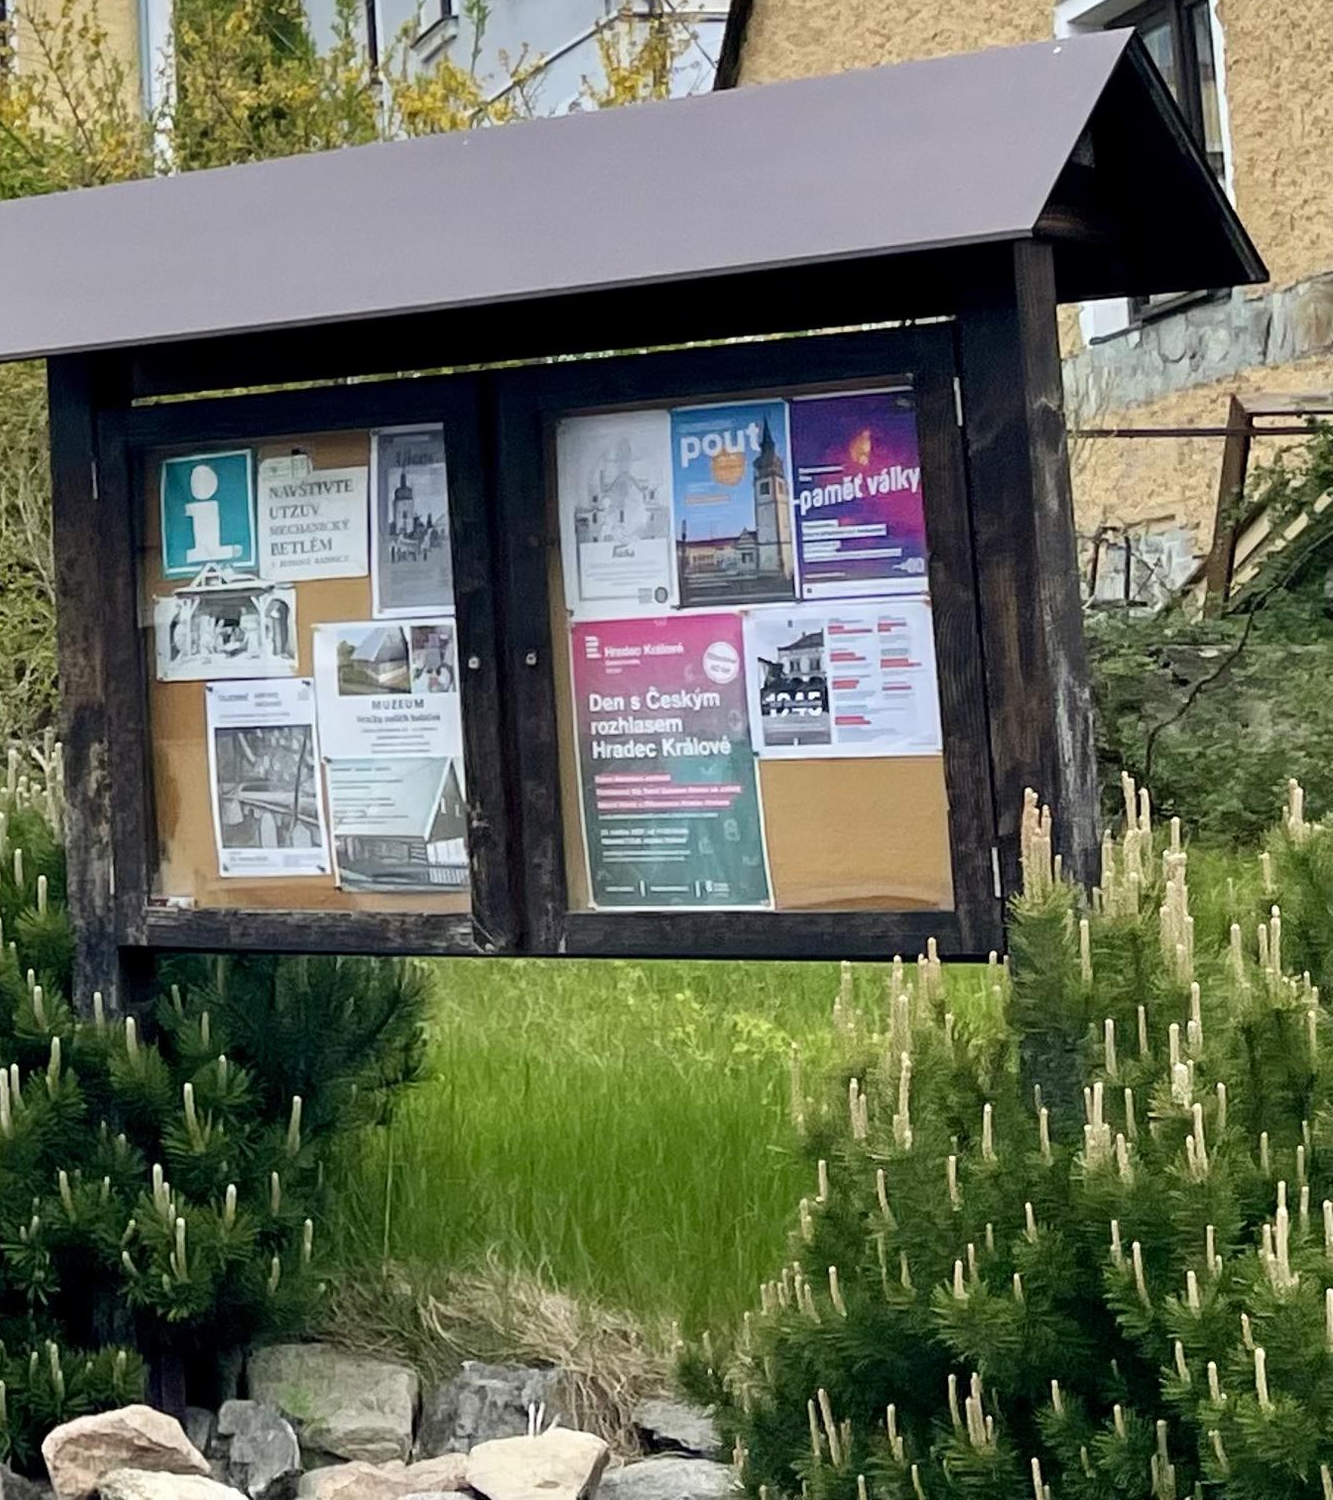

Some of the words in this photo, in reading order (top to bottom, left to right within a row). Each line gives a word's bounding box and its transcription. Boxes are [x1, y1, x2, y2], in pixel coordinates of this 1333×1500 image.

[866, 464, 920, 497] války
[270, 537, 333, 556] BETLÉM
[371, 699, 425, 710] MUZEUM
[589, 693, 625, 712] Den
[630, 696, 641, 711] s
[645, 686, 721, 711] Českým
[590, 716, 683, 735] rozhlasem
[592, 740, 657, 759] Hradec
[661, 736, 732, 757] Králové
